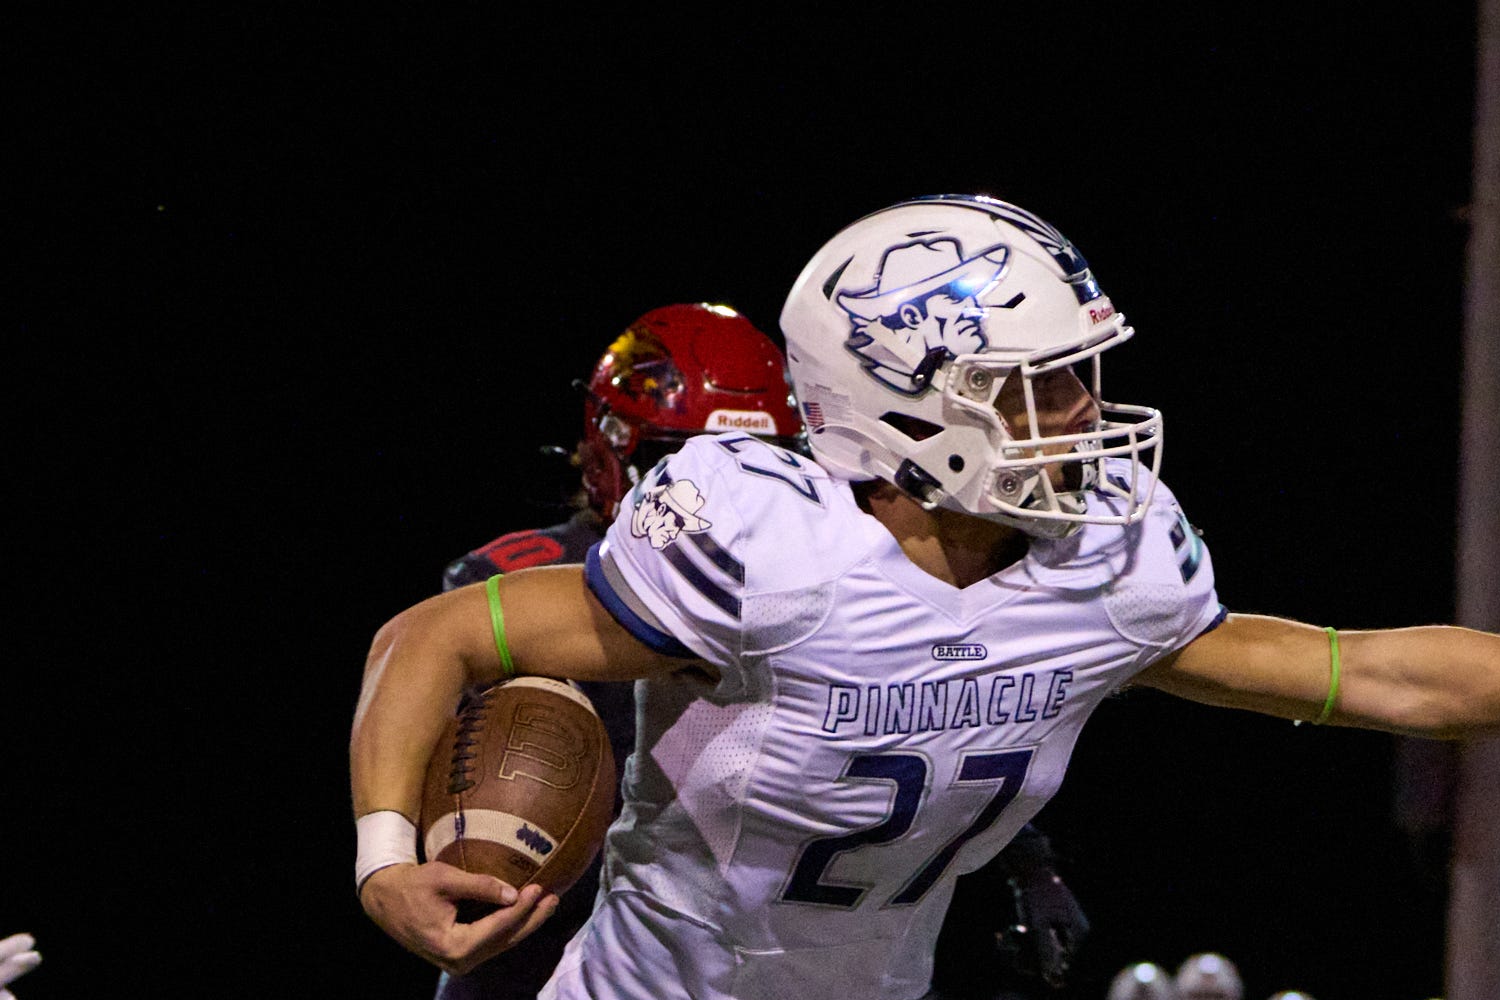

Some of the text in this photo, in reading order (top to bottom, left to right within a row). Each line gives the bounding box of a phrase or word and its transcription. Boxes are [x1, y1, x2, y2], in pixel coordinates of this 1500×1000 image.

[717, 414, 769, 429] Riddell
[936, 646, 984, 657] BATTLE
[822, 670, 1074, 737] PINNACLE
[775, 741, 1044, 911] 27
